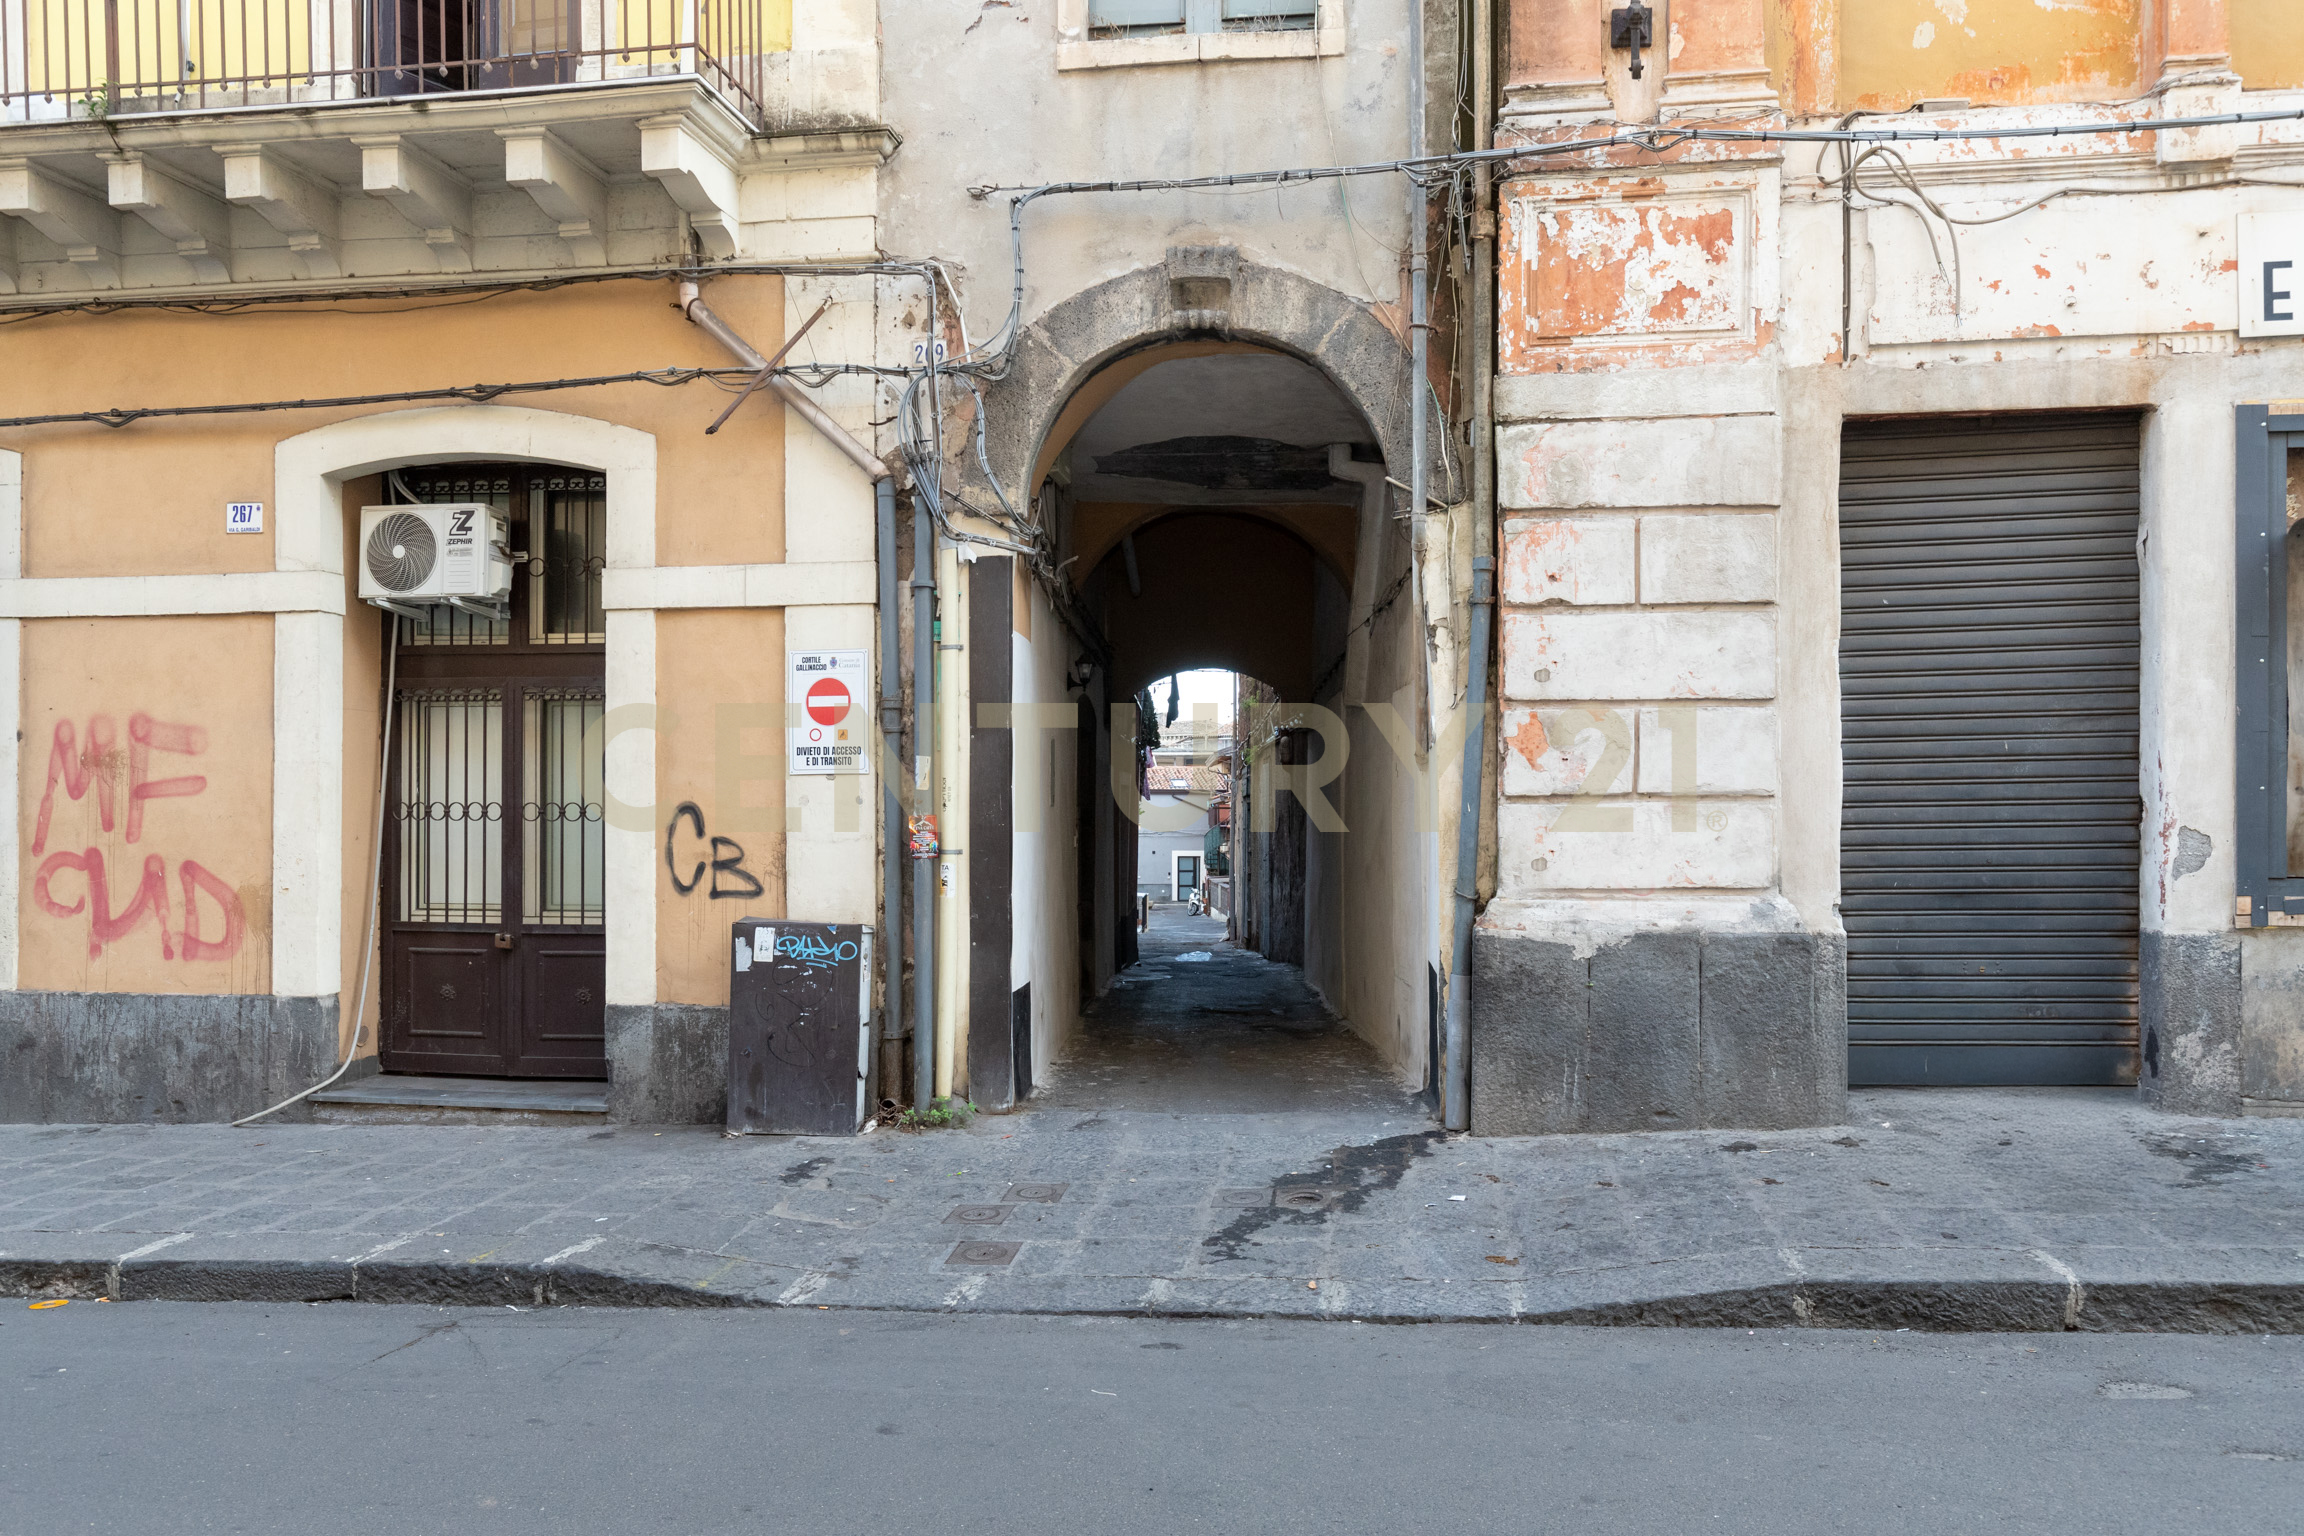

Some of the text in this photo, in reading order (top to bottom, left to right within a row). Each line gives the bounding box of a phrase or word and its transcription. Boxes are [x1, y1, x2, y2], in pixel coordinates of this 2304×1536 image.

[232, 505, 253, 523] 267
[801, 656, 821, 664] CORTILE
[796, 746, 862, 756] DIVIETO DI ACCESSO
[806, 756, 852, 766] E DI TRANSITO
